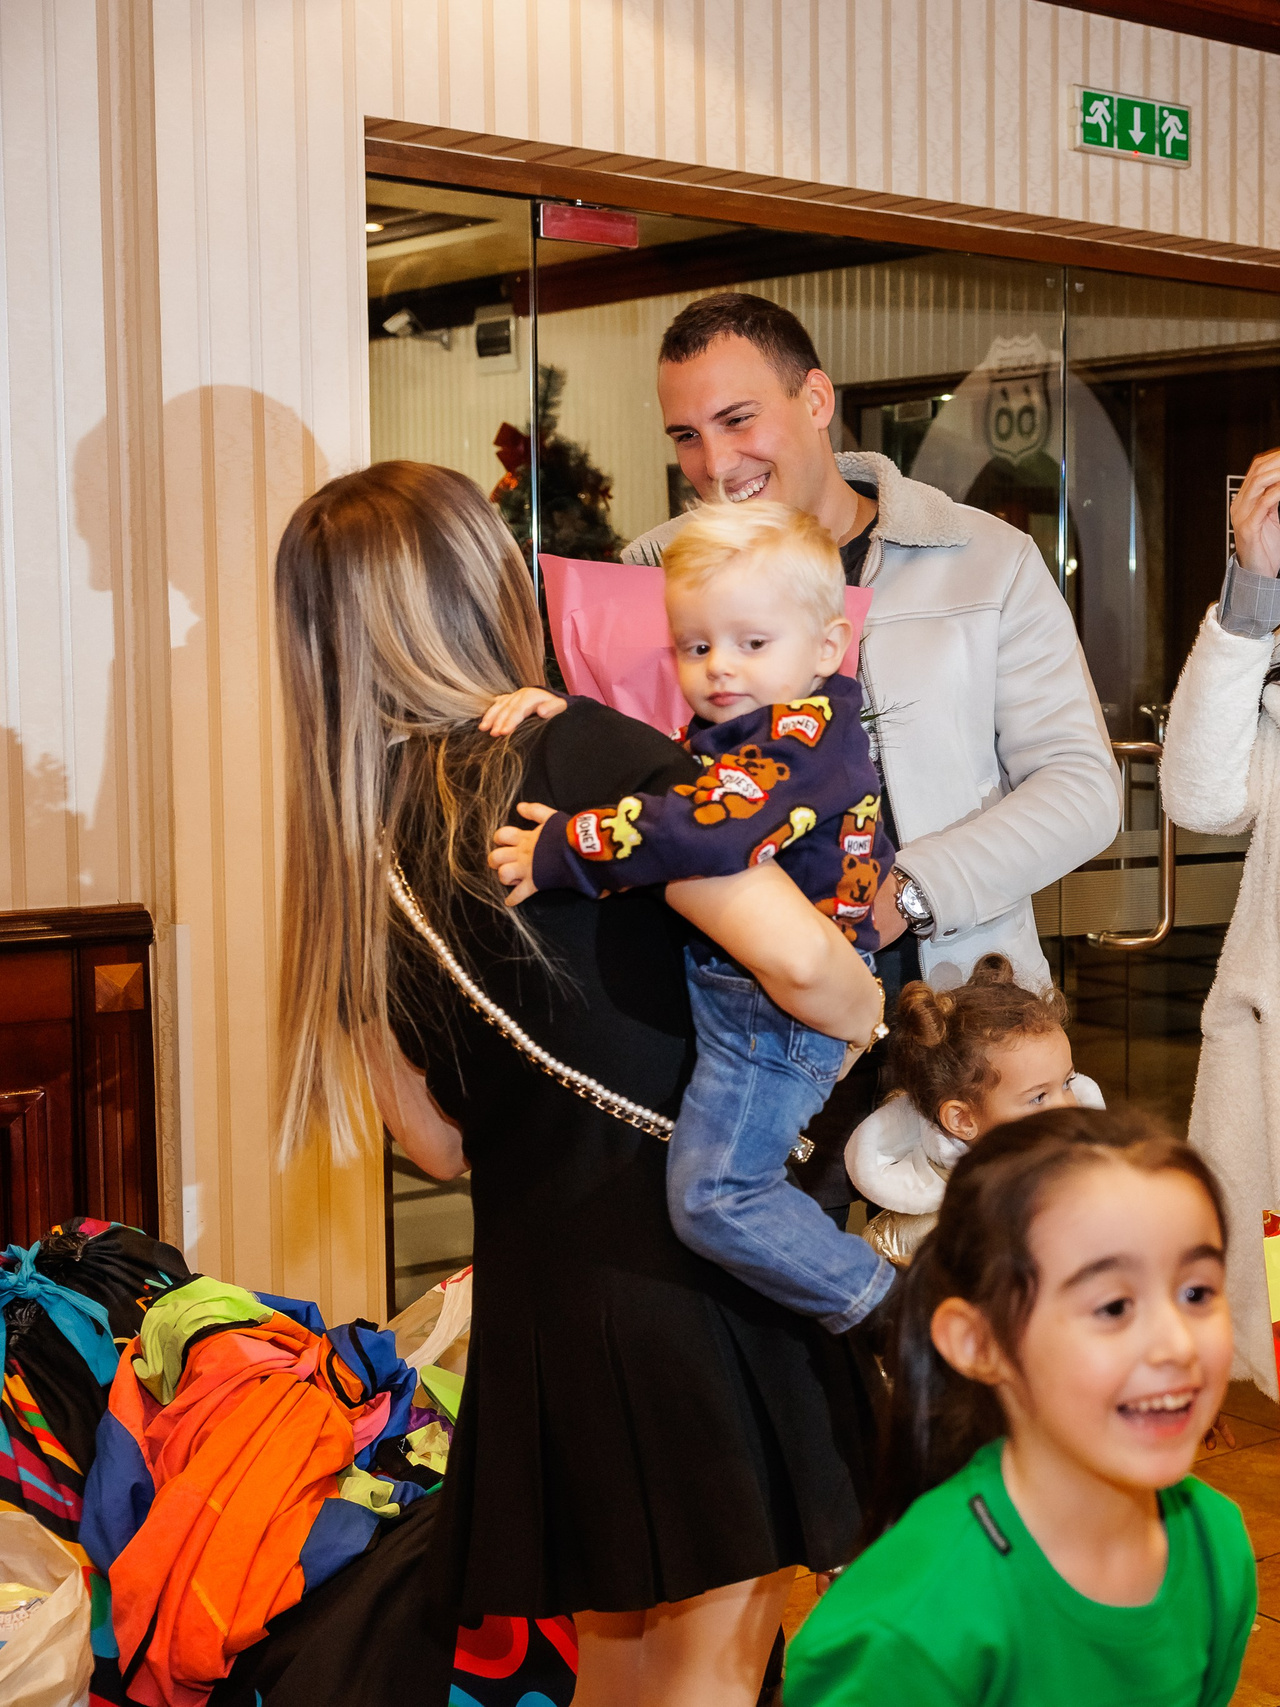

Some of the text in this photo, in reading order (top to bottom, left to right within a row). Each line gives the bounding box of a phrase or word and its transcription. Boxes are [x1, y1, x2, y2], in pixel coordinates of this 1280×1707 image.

[781, 718, 818, 734] HONEY
[723, 774, 760, 797] GUESS
[577, 815, 597, 851] HONEY
